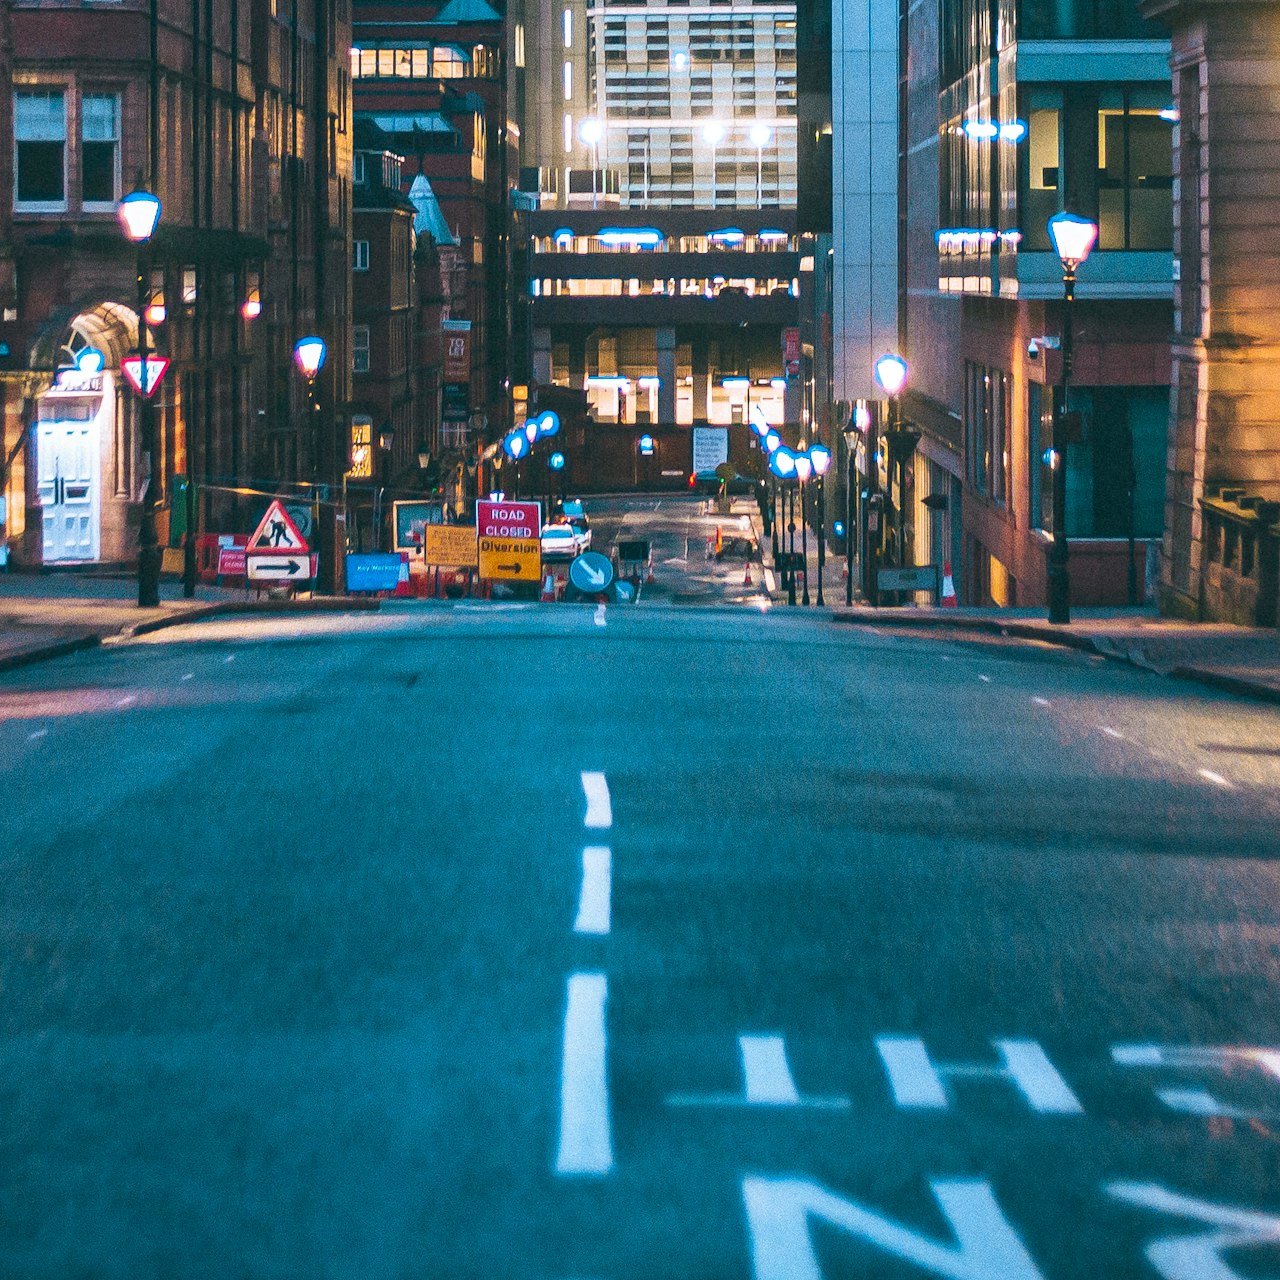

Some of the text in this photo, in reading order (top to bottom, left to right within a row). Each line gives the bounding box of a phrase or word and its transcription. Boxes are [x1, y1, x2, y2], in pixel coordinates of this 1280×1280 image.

[491, 509, 525, 521] ROAD
[486, 526, 532, 538] CLOSED
[481, 541, 538, 554] Diversion
